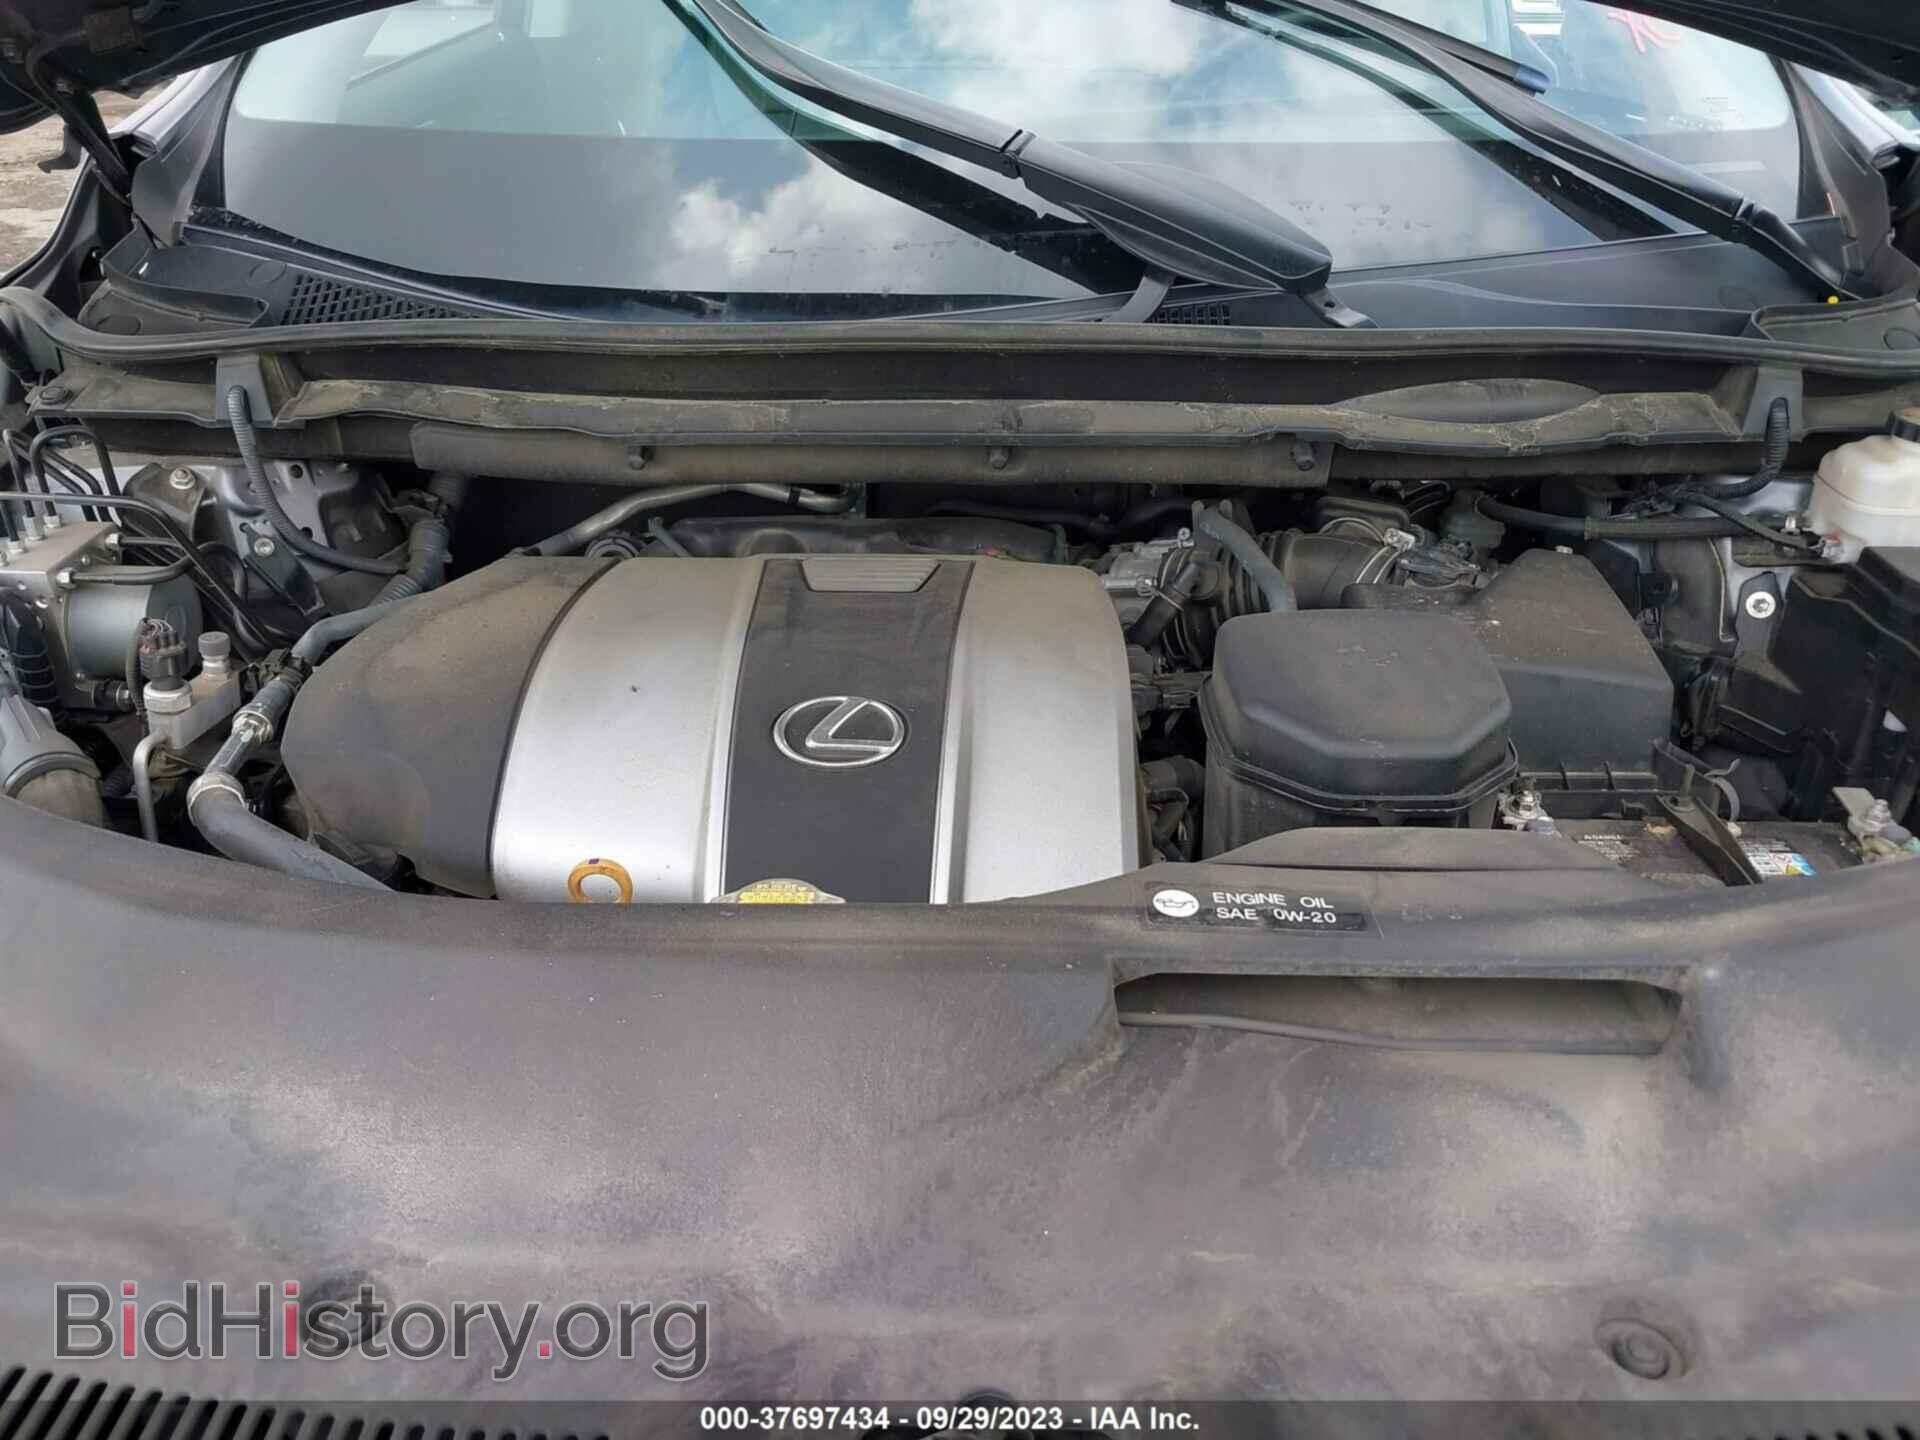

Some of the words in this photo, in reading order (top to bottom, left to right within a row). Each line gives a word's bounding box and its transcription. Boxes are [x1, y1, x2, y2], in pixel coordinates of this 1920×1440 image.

[1212, 891, 1287, 906] ENGINE
[1300, 896, 1335, 909] OIL
[1216, 907, 1258, 920] SAE
[1273, 909, 1337, 924] 0W-20
